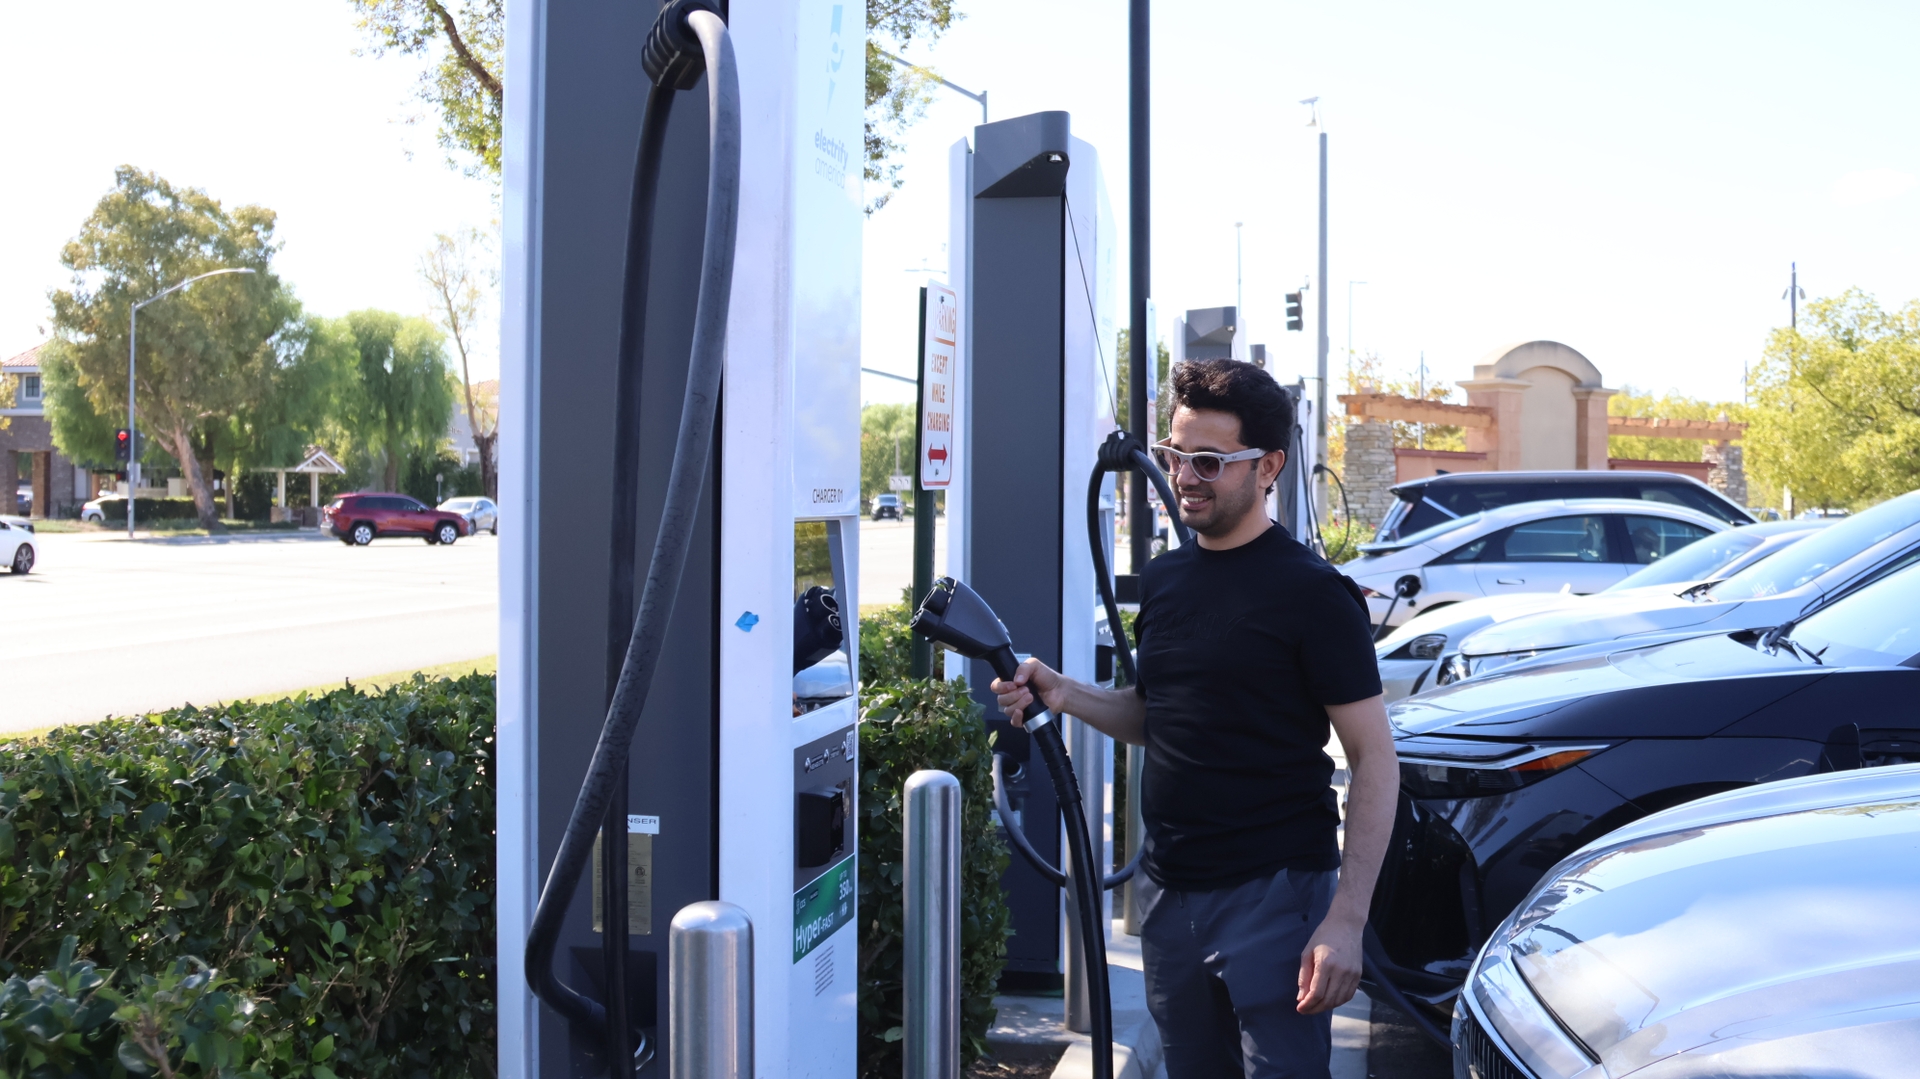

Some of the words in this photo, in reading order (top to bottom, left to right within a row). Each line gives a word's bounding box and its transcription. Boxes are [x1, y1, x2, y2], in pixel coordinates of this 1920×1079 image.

[814, 128, 849, 171] electrify
[814, 157, 846, 189] america
[931, 353, 949, 375] EXCEPT
[931, 382, 946, 404] WHILE
[927, 411, 950, 432] CHARGING
[812, 488, 837, 503] CHARGER
